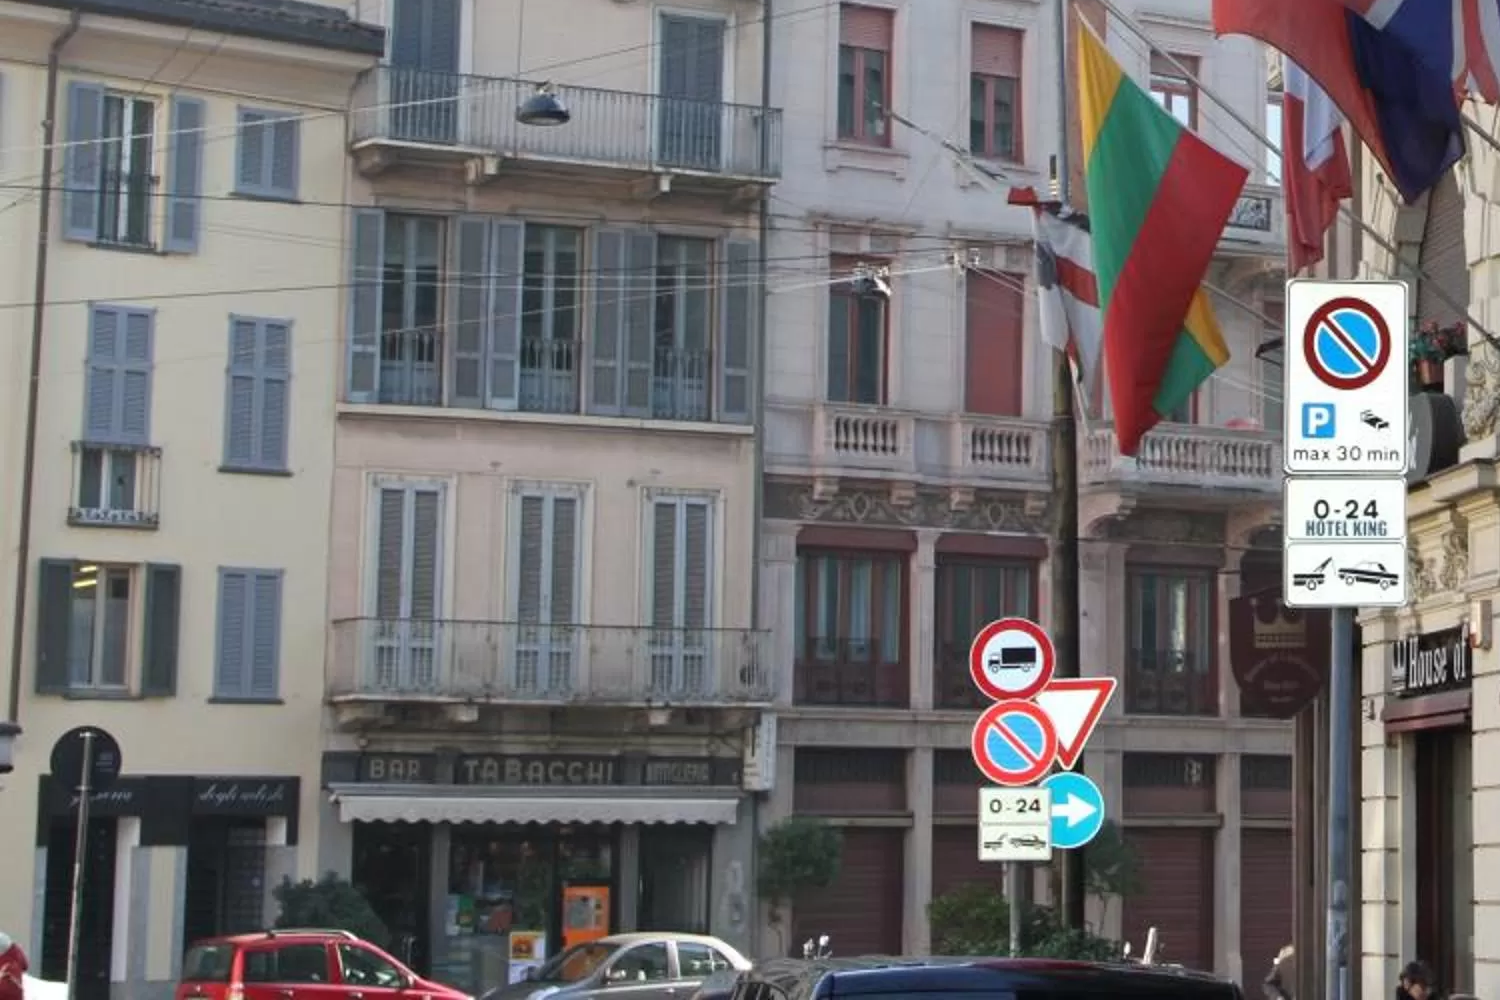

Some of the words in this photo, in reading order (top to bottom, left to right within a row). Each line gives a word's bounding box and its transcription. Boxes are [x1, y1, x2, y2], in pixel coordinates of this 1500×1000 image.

[1307, 407, 1330, 435] P
[1293, 449, 1331, 461] max
[1336, 446, 1362, 461] 30
[1367, 446, 1400, 461] min
[1305, 520, 1348, 537] HOTEL
[1353, 520, 1388, 537] KING
[1408, 634, 1448, 688] House
[1453, 622, 1468, 682] of
[370, 759, 421, 778] BAR
[463, 757, 613, 785] TABACCHI
